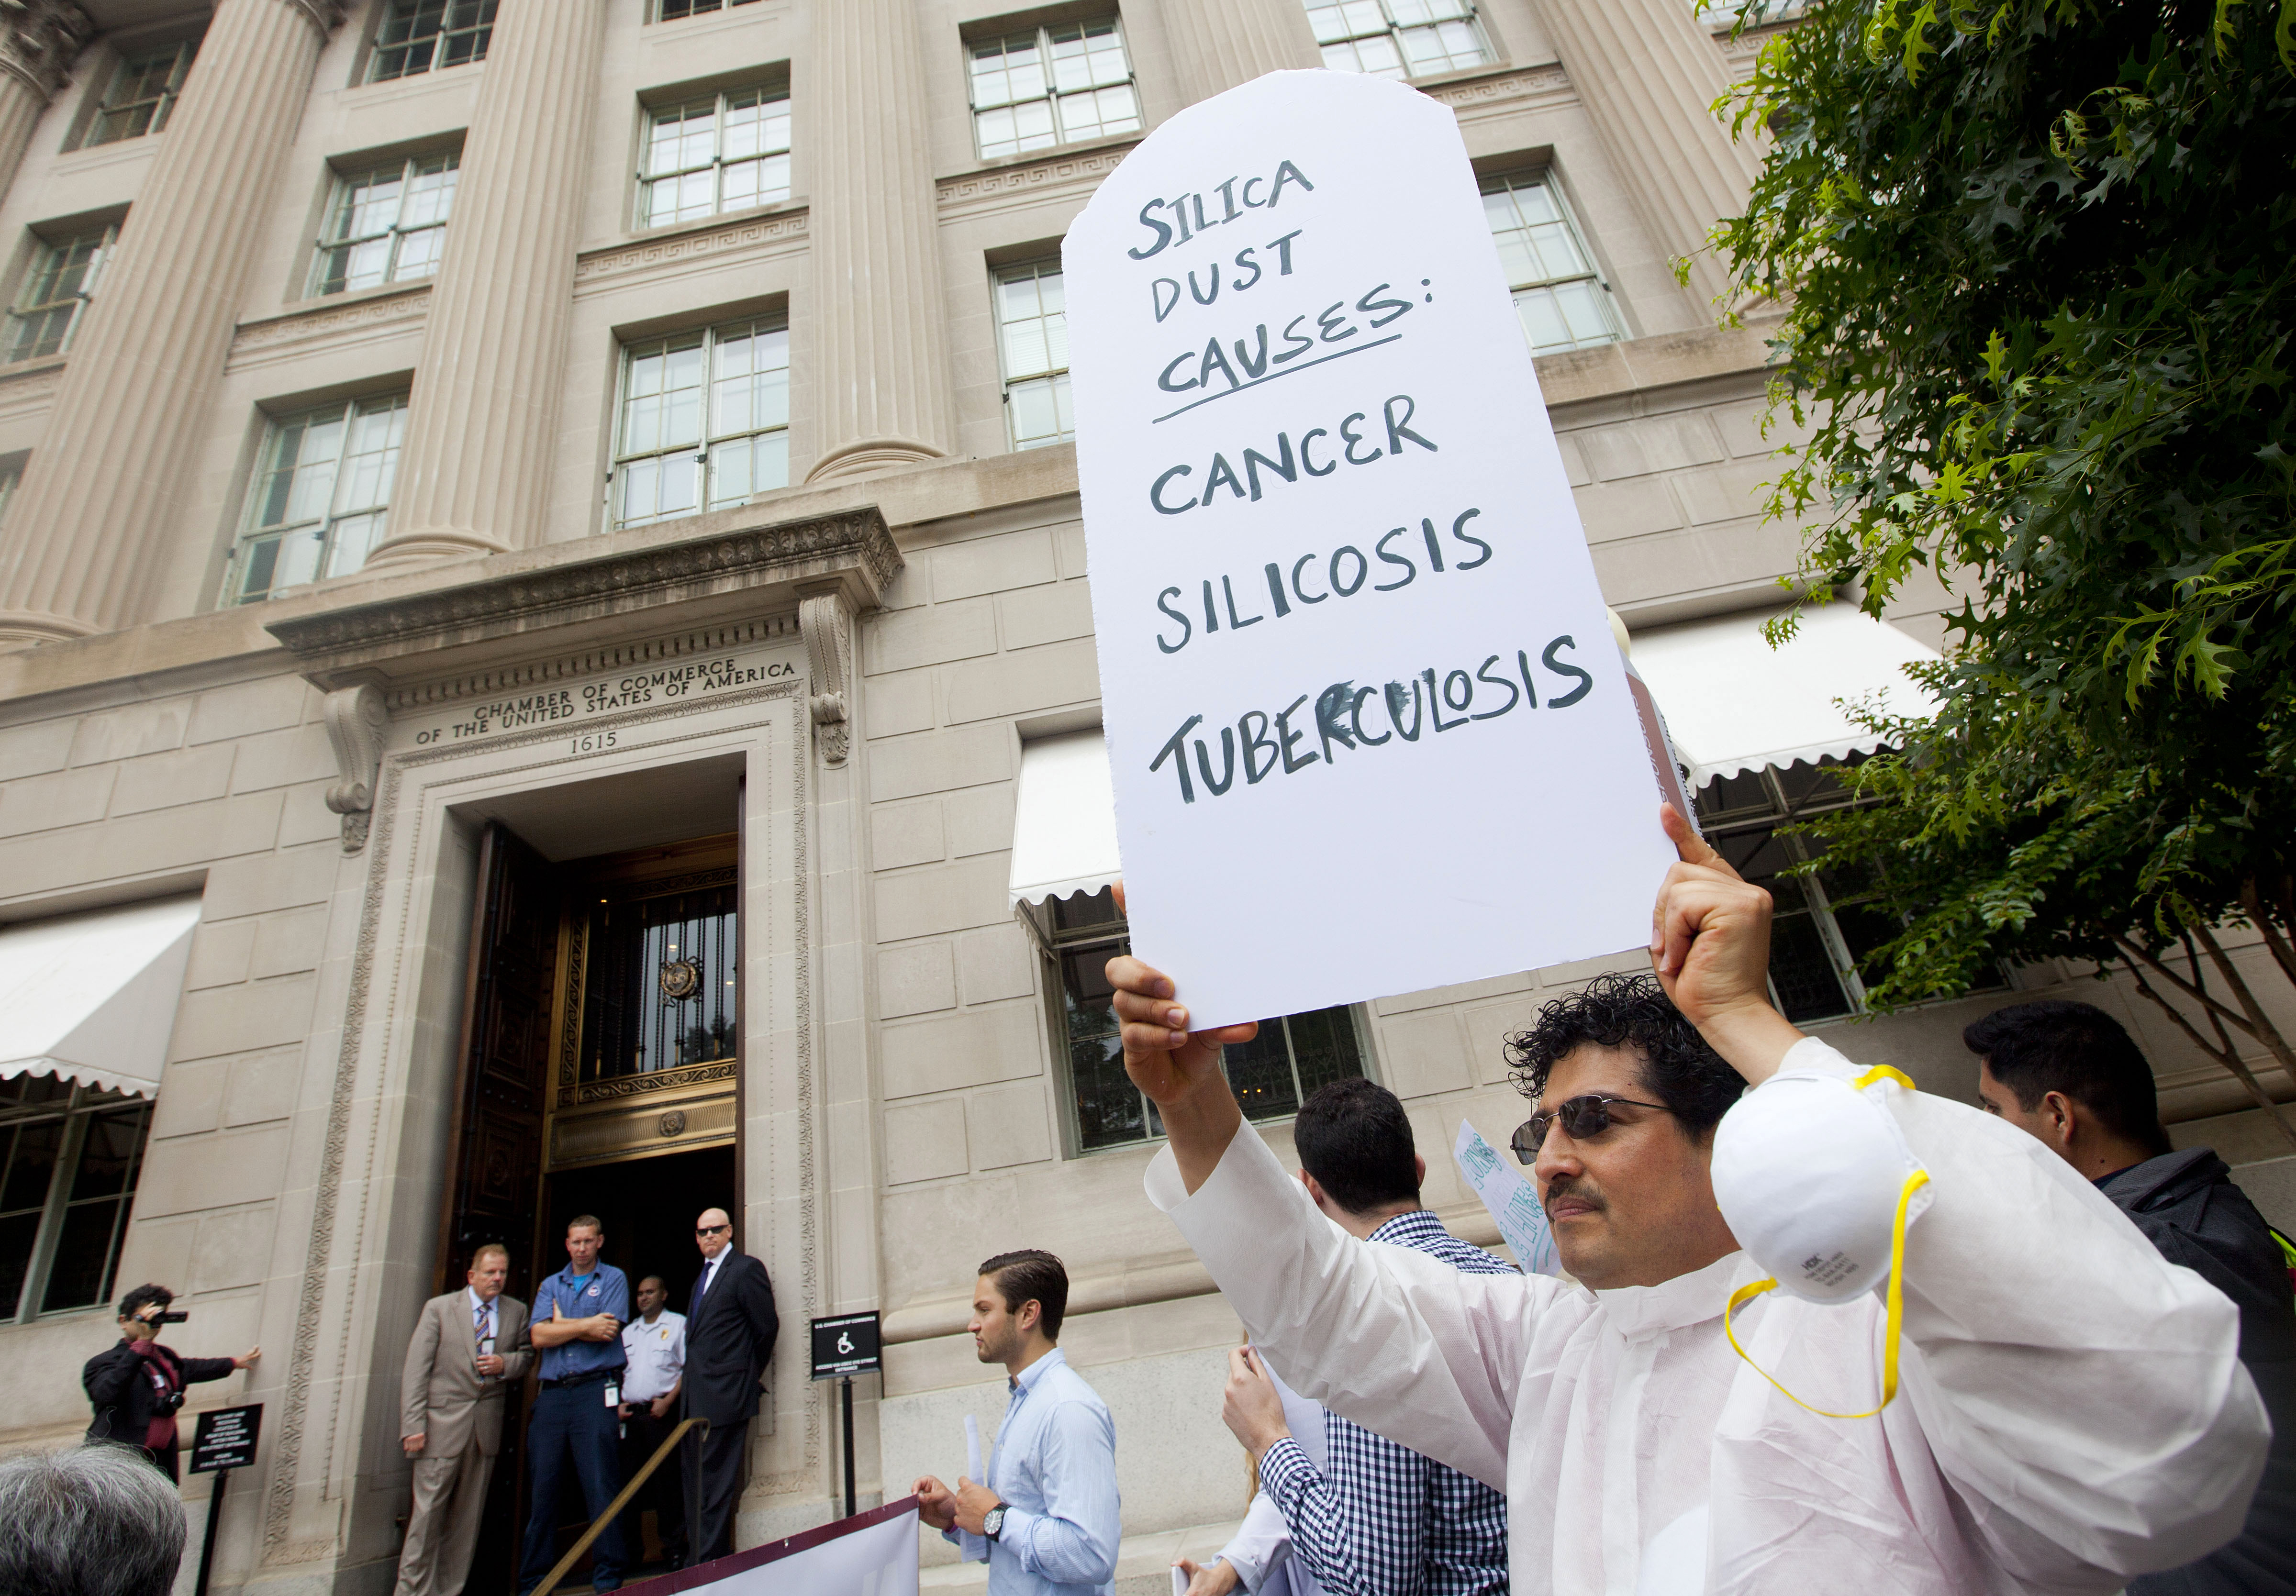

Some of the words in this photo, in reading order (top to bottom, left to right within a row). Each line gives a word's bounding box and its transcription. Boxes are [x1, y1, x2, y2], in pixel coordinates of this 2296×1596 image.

[1127, 160, 1314, 260] SILICA
[1152, 229, 1303, 323] DUST
[1158, 278, 1432, 392] CAUSES:
[1150, 395, 1438, 514] CANCER
[1157, 508, 1492, 654] SILICOSIS
[416, 729, 441, 744] OF
[453, 720, 489, 737] THE
[502, 704, 574, 728] UNITED
[586, 689, 651, 712] STATES
[666, 681, 690, 696] OF
[702, 662, 795, 690] AMERICA
[474, 691, 571, 720] CHAMBER
[583, 683, 608, 699] OF
[620, 659, 735, 691] COMMERCE
[1149, 635, 1593, 803] TUBERCULOSIS
[571, 732, 616, 754] 1615
